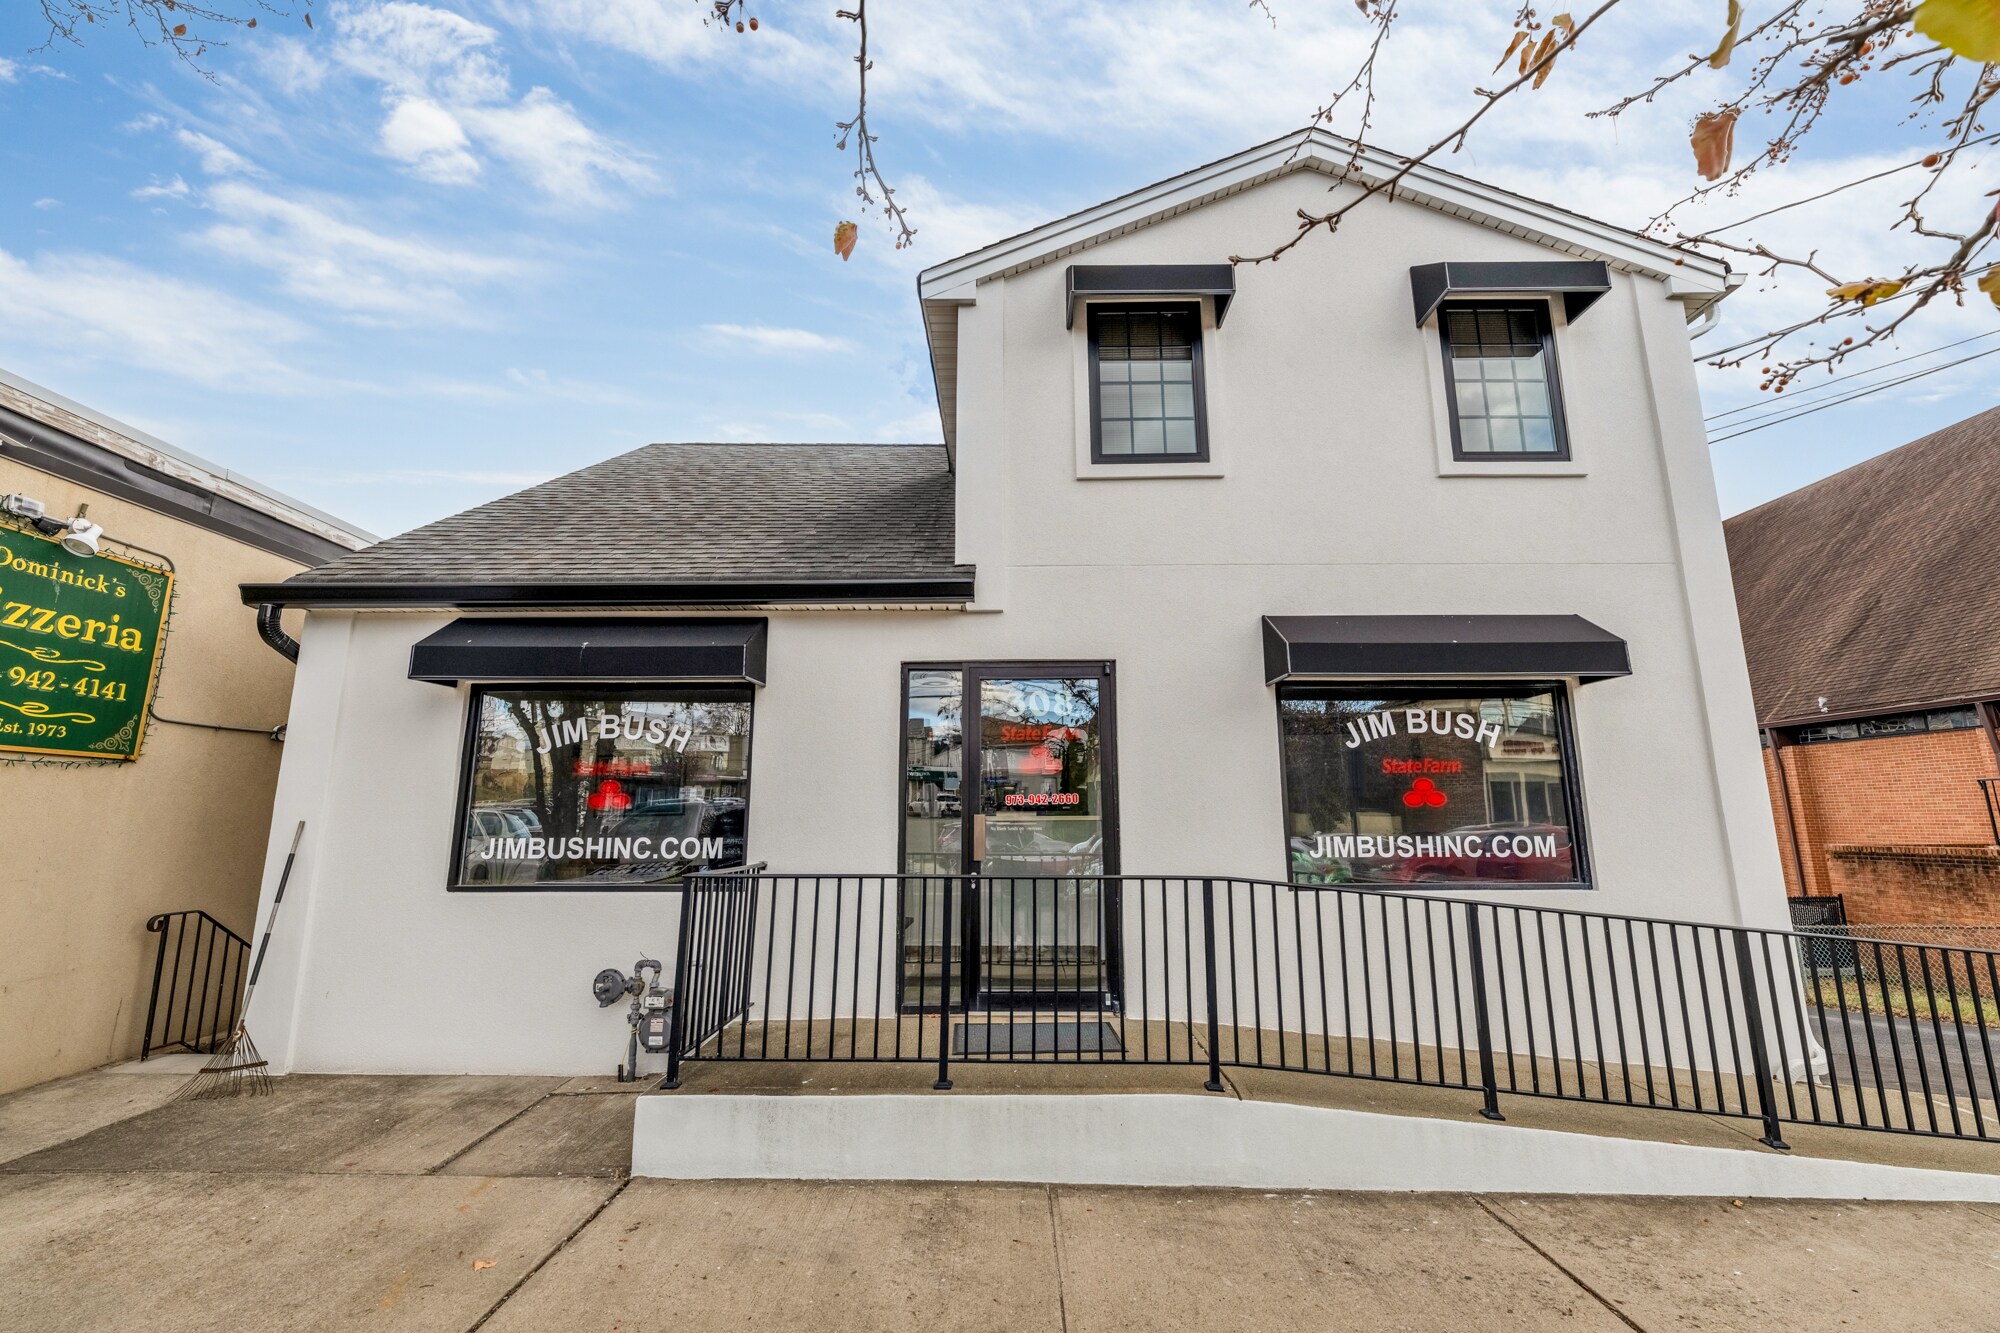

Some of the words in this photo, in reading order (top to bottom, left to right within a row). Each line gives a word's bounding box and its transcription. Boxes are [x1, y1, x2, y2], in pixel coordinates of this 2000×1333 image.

[0, 545, 127, 598] Dominick's
[0, 594, 143, 652] zzeria
[1006, 690, 1073, 717] 308
[28, 722, 67, 738] 1973
[536, 717, 588, 754] JIM
[600, 714, 693, 754] BUSH
[1345, 711, 1396, 749] JIM
[1406, 708, 1502, 749] BUSH
[1005, 793, 1079, 806] 973-942-2660
[480, 837, 723, 860] JIMBUSHINC.COM
[1309, 835, 1557, 859] JIMBUSHINC.COM
